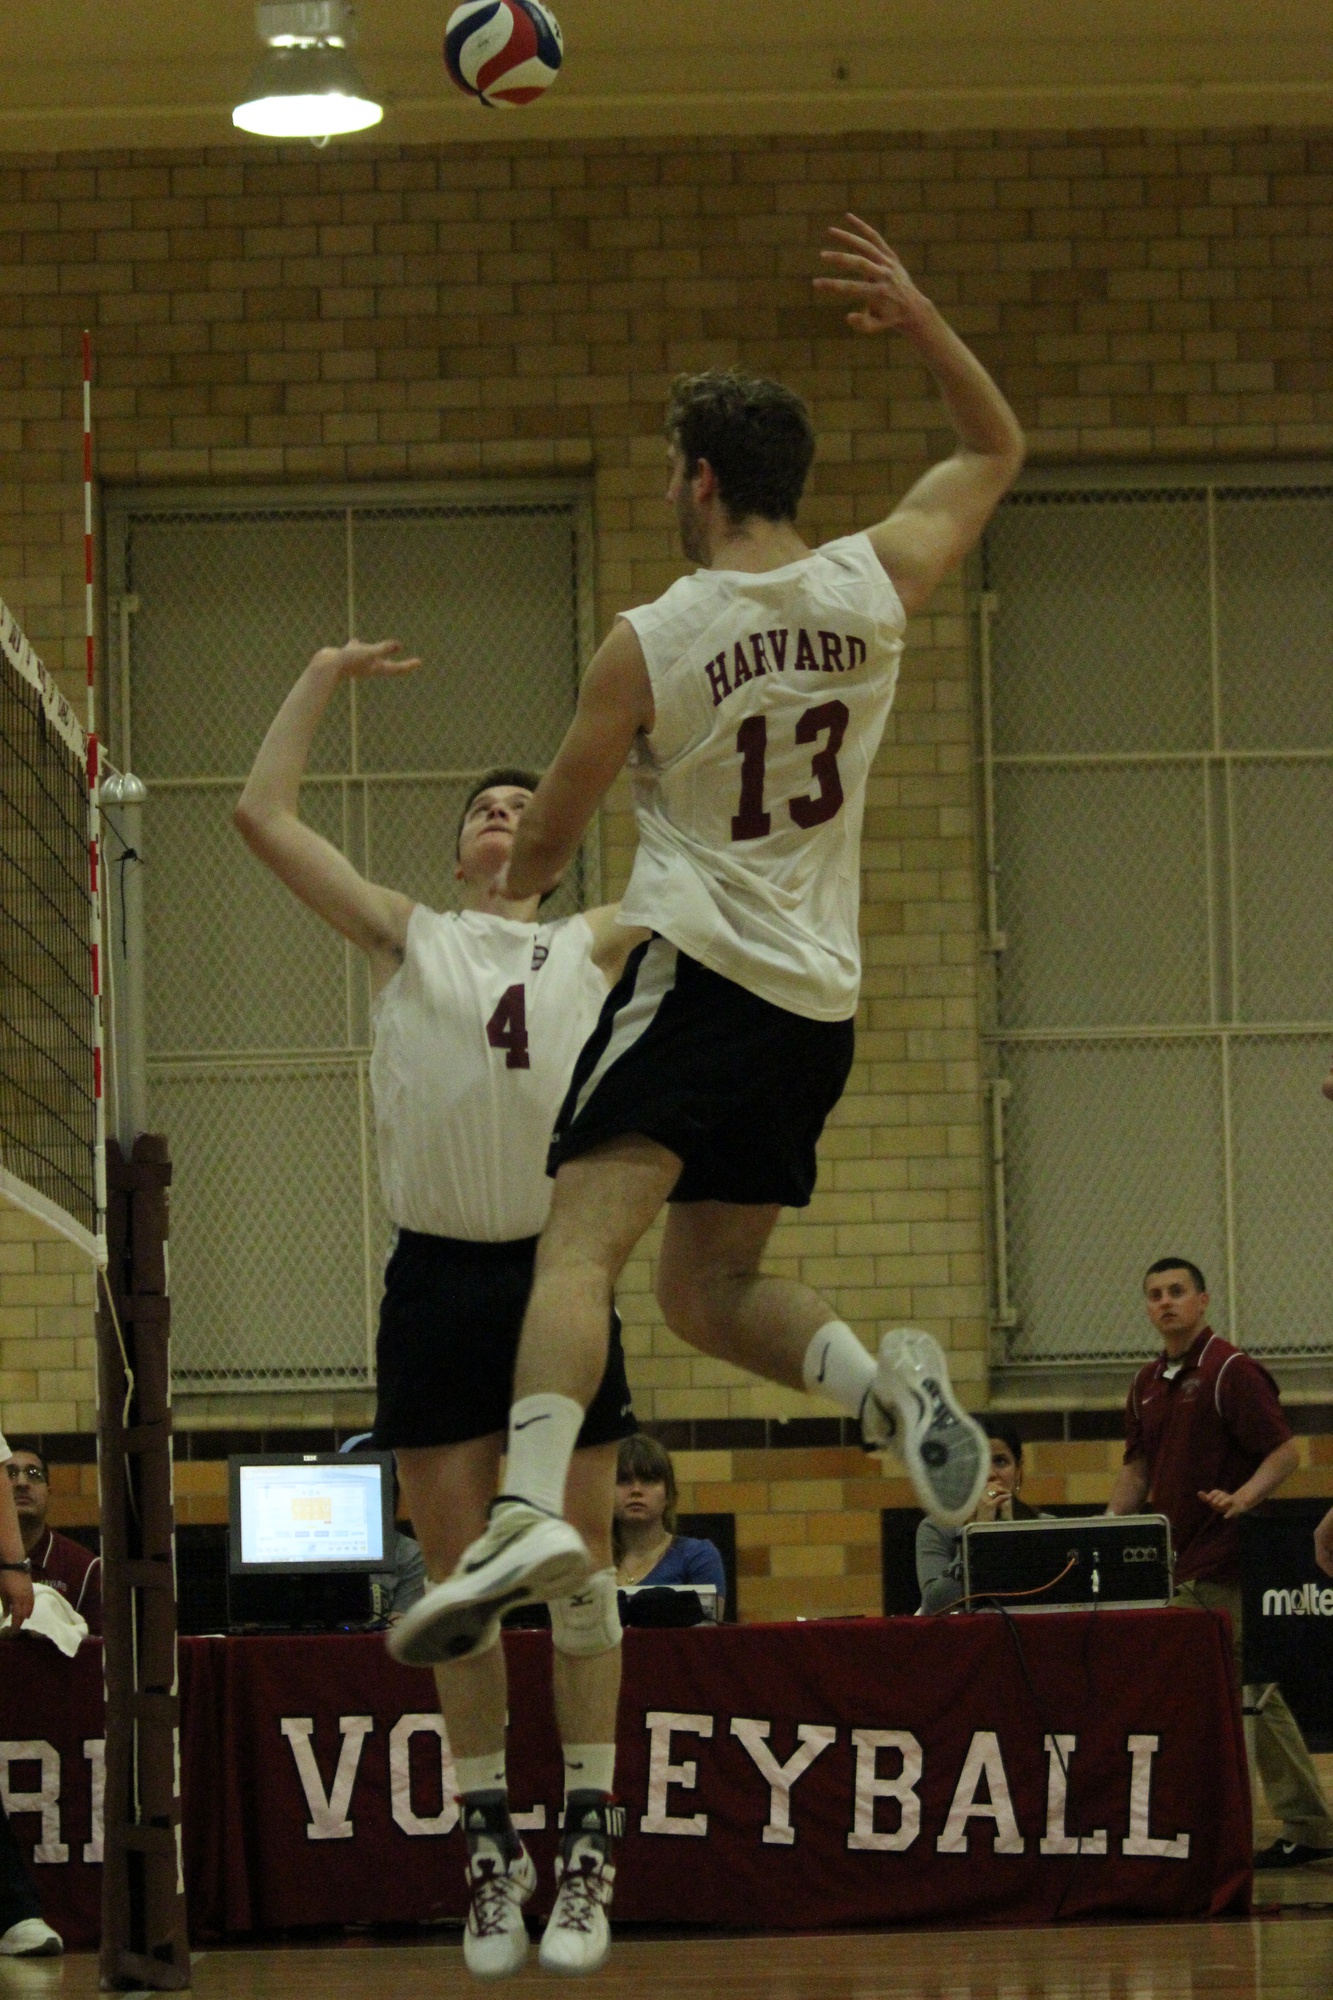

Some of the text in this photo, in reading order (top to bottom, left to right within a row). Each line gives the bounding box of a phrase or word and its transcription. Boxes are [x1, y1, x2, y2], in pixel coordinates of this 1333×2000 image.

[704, 628, 867, 707] HARVARD
[731, 699, 849, 841] 13
[486, 983, 530, 1069] 4
[280, 1711, 1190, 1859] VOEYBALL
